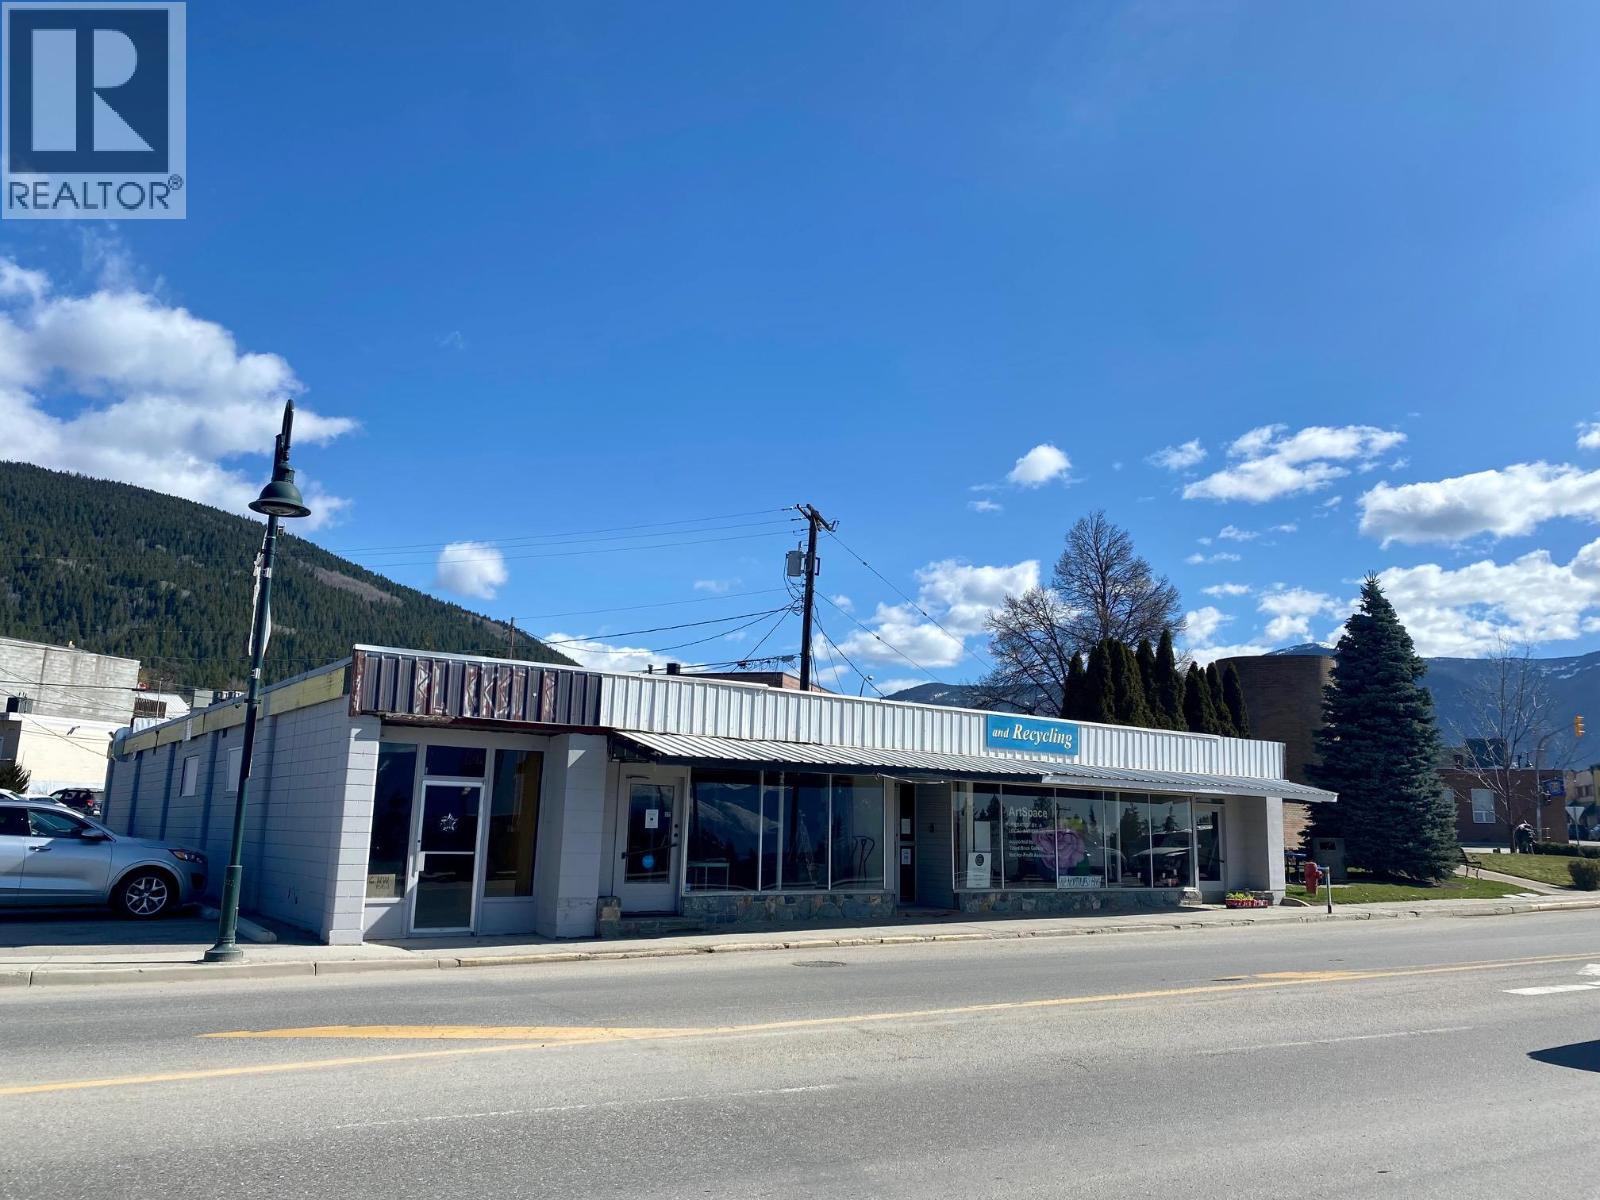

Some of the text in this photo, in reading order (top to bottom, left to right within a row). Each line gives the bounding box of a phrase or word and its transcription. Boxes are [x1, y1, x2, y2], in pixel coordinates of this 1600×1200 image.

[992, 724, 1073, 749] and Recycling
[1008, 806, 1048, 819] ArtSpace
